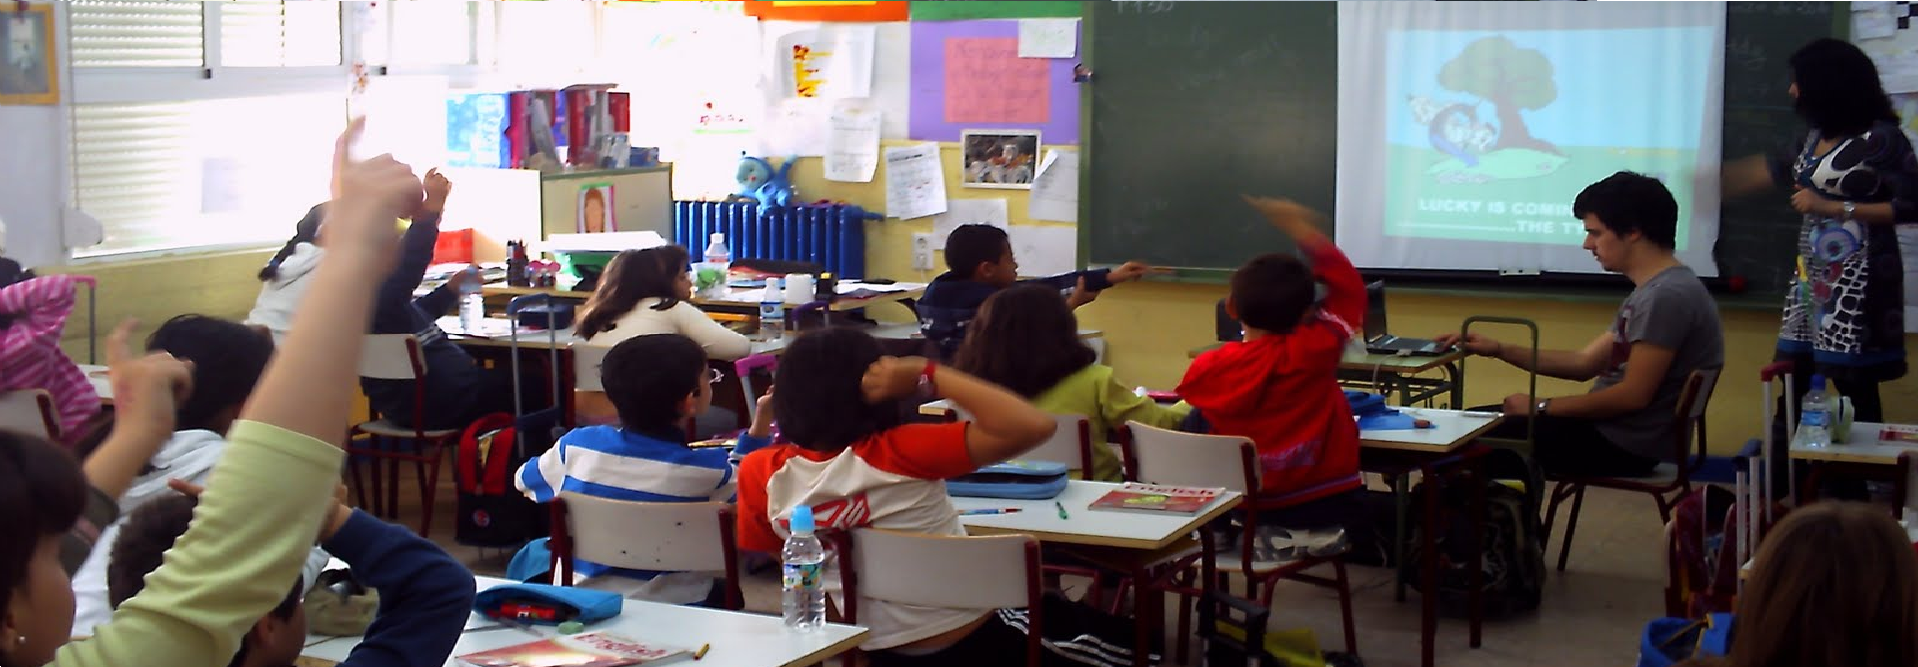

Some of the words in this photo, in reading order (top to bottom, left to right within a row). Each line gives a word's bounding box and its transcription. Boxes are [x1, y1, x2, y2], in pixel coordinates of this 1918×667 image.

[1418, 198, 1480, 213] LUCKY
[1487, 201, 1505, 214] IS
[1511, 202, 1573, 217] COMIN
[1562, 222, 1584, 235] TY
